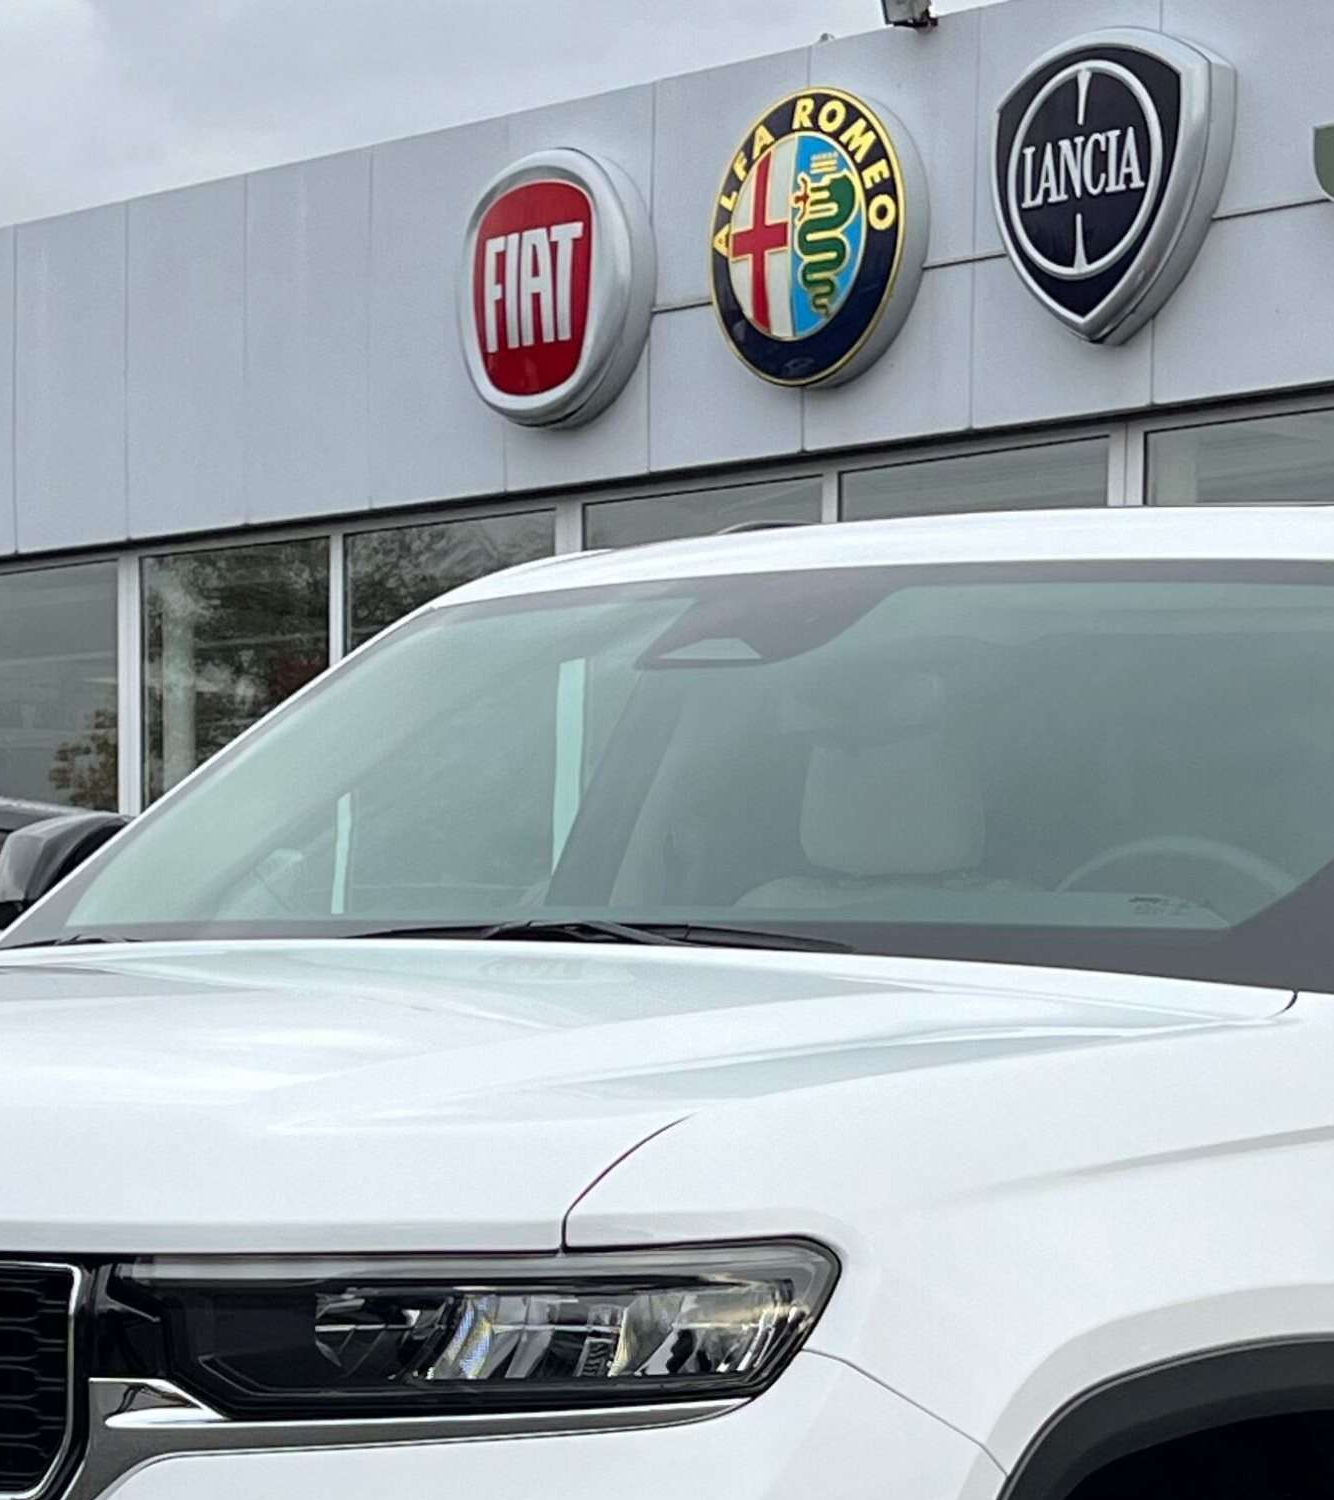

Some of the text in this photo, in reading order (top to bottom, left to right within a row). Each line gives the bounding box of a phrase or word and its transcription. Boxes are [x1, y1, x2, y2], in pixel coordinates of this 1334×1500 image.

[713, 97, 897, 258] ALFA ROMEO
[1021, 125, 1146, 209] LANCIA
[484, 220, 584, 354] FIAT
